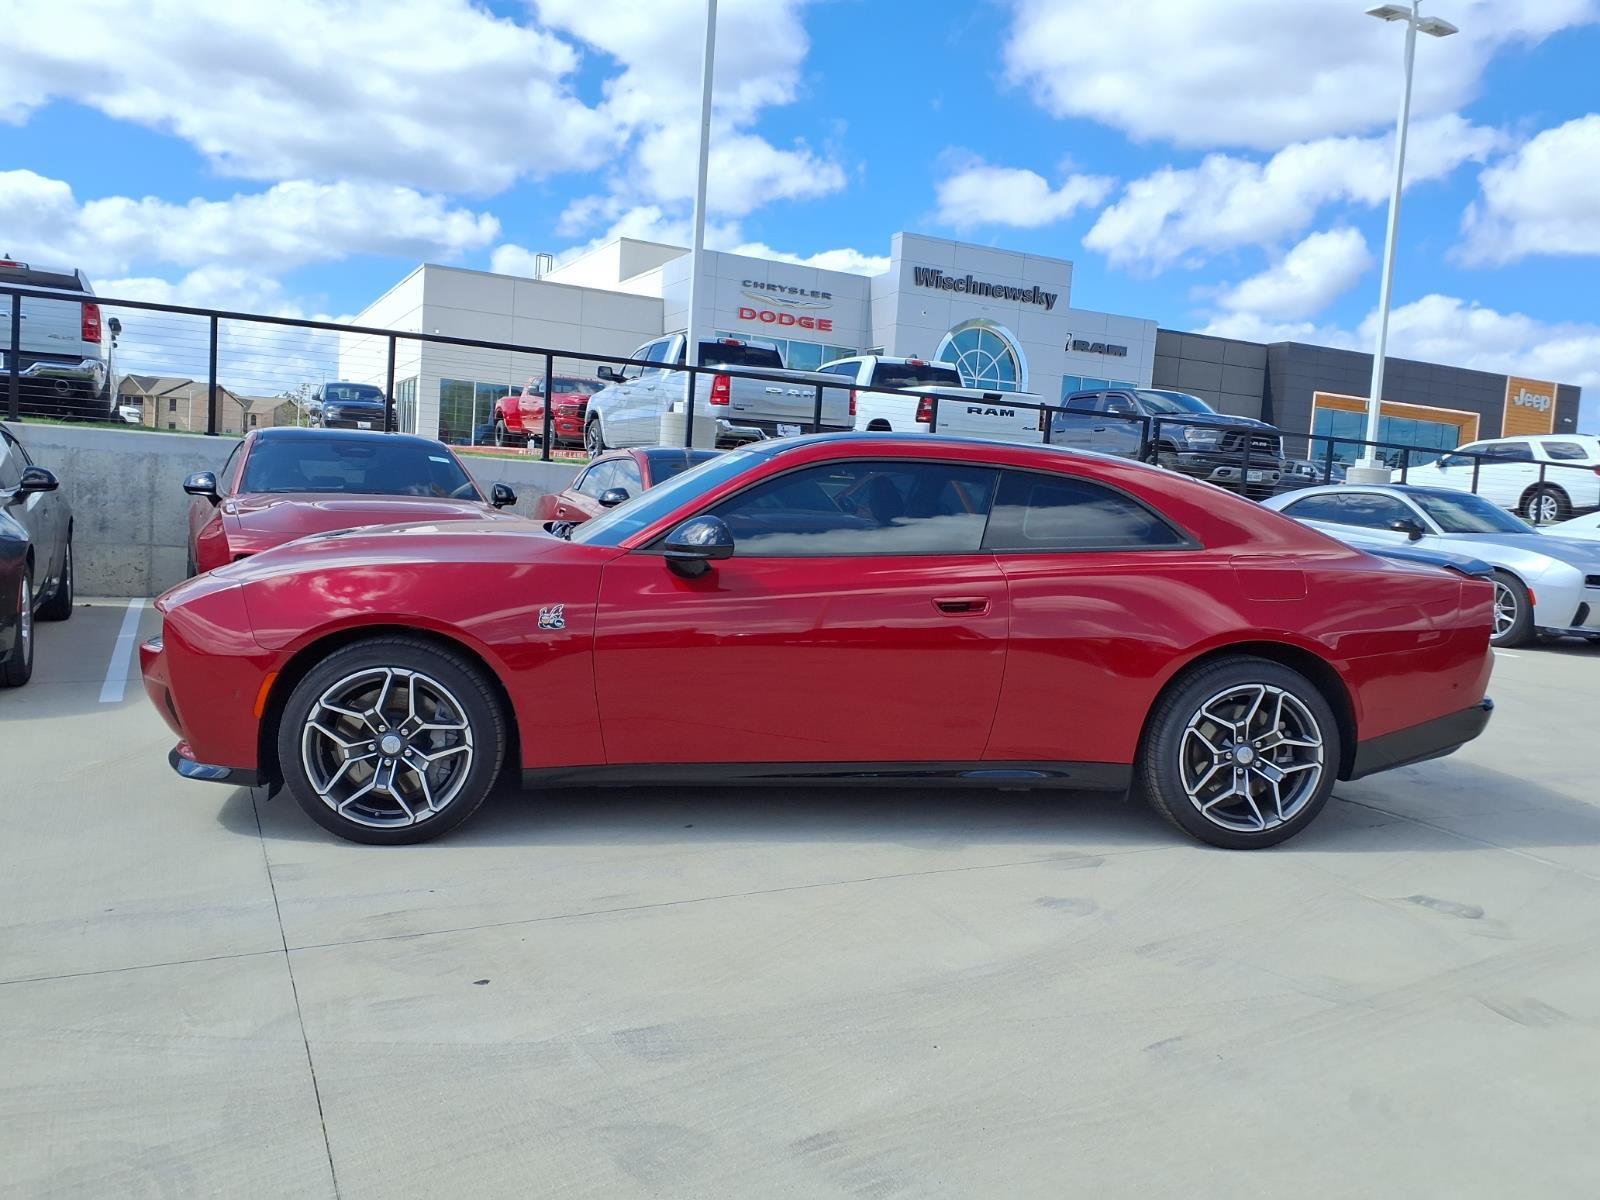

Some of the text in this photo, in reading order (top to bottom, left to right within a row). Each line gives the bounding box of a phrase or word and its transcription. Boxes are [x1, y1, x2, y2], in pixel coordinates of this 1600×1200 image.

[742, 280, 832, 300] CHRYSLER
[914, 266, 1058, 310] Wischnewsky
[739, 307, 833, 332] DODGE
[1072, 339, 1128, 357] RAM
[1514, 388, 1550, 411] Jeep
[967, 406, 1015, 417] RAM
